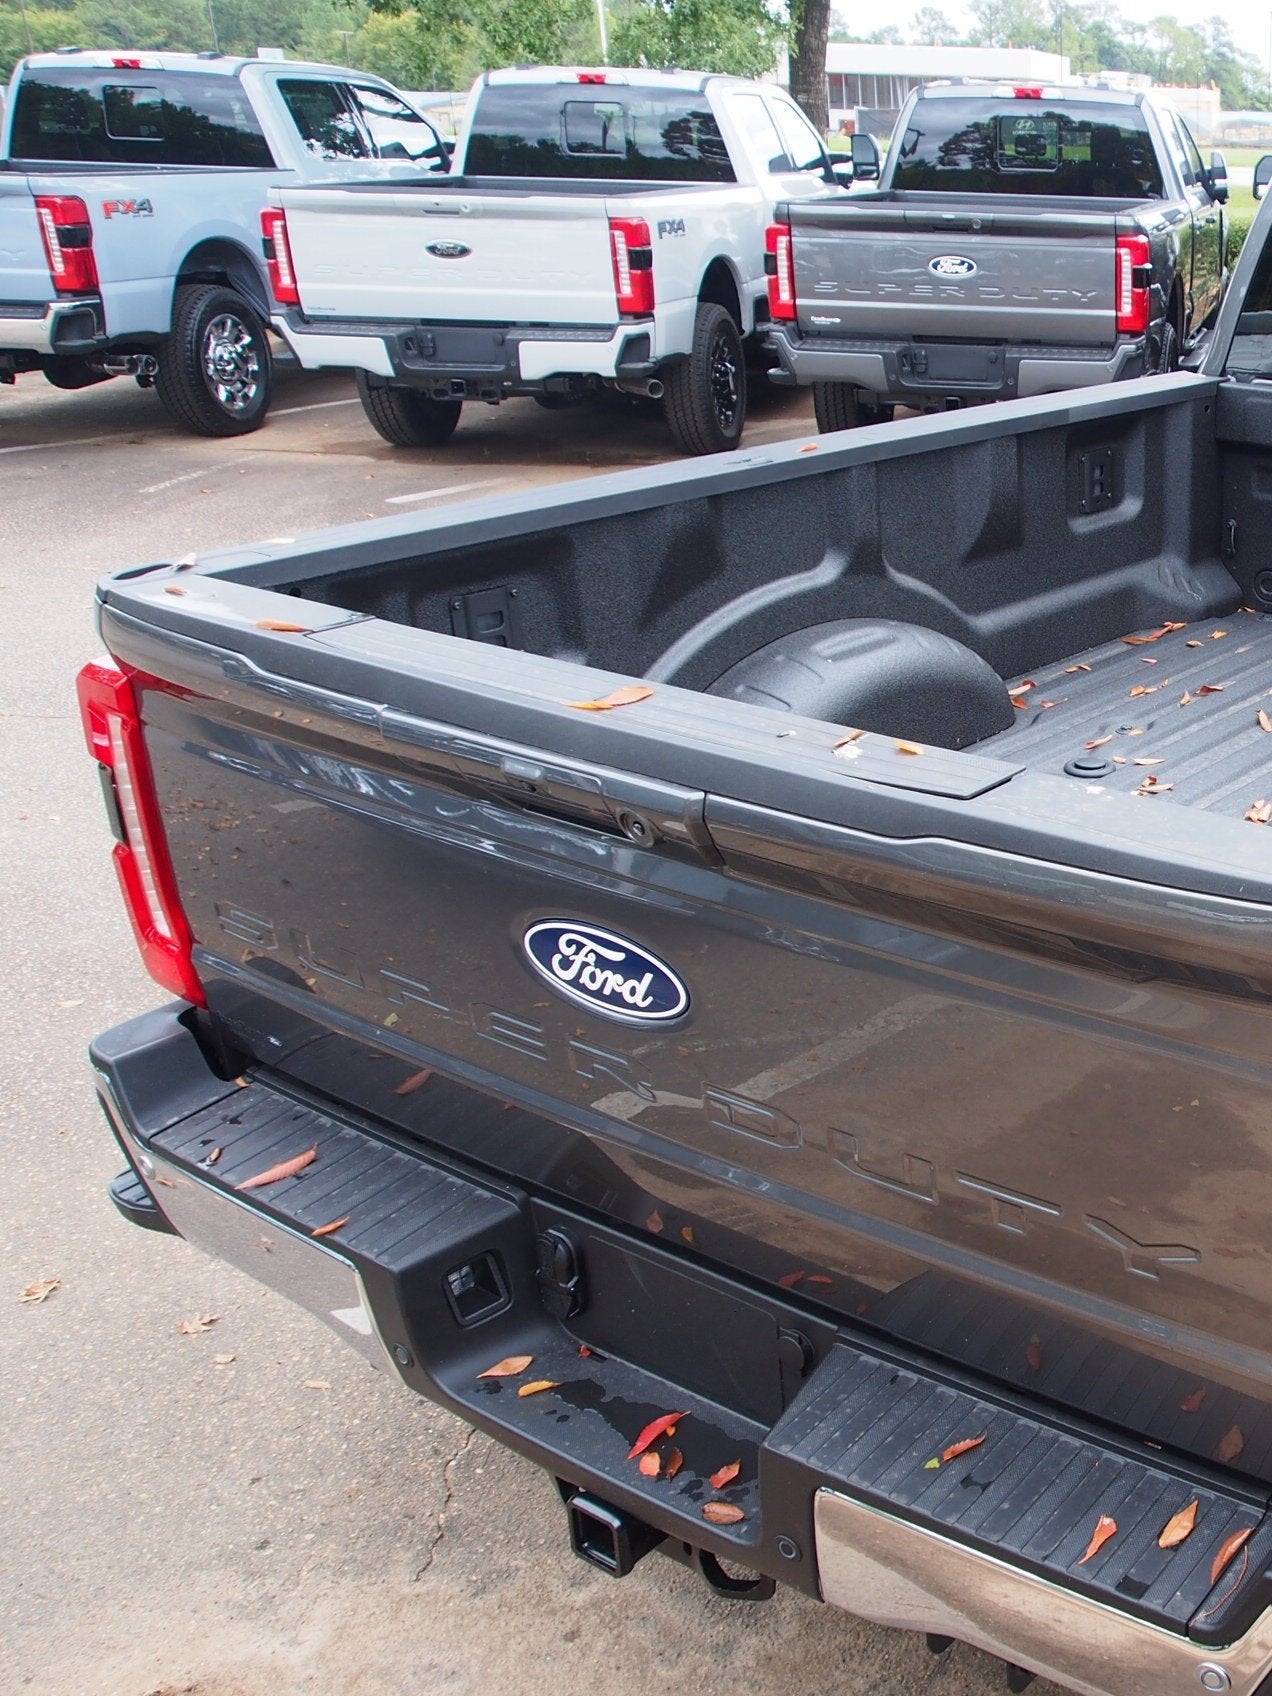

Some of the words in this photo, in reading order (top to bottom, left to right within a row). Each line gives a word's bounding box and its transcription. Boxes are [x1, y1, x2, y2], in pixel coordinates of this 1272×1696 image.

[102, 199, 154, 220] FX4
[657, 218, 686, 239] FX4
[937, 258, 968, 273] Ford
[813, 280, 966, 298] SUPER
[978, 286, 1098, 302] DUTY
[551, 932, 654, 1008] Ford
[213, 900, 656, 1102] SUPER
[702, 1081, 1201, 1281] DUTY
